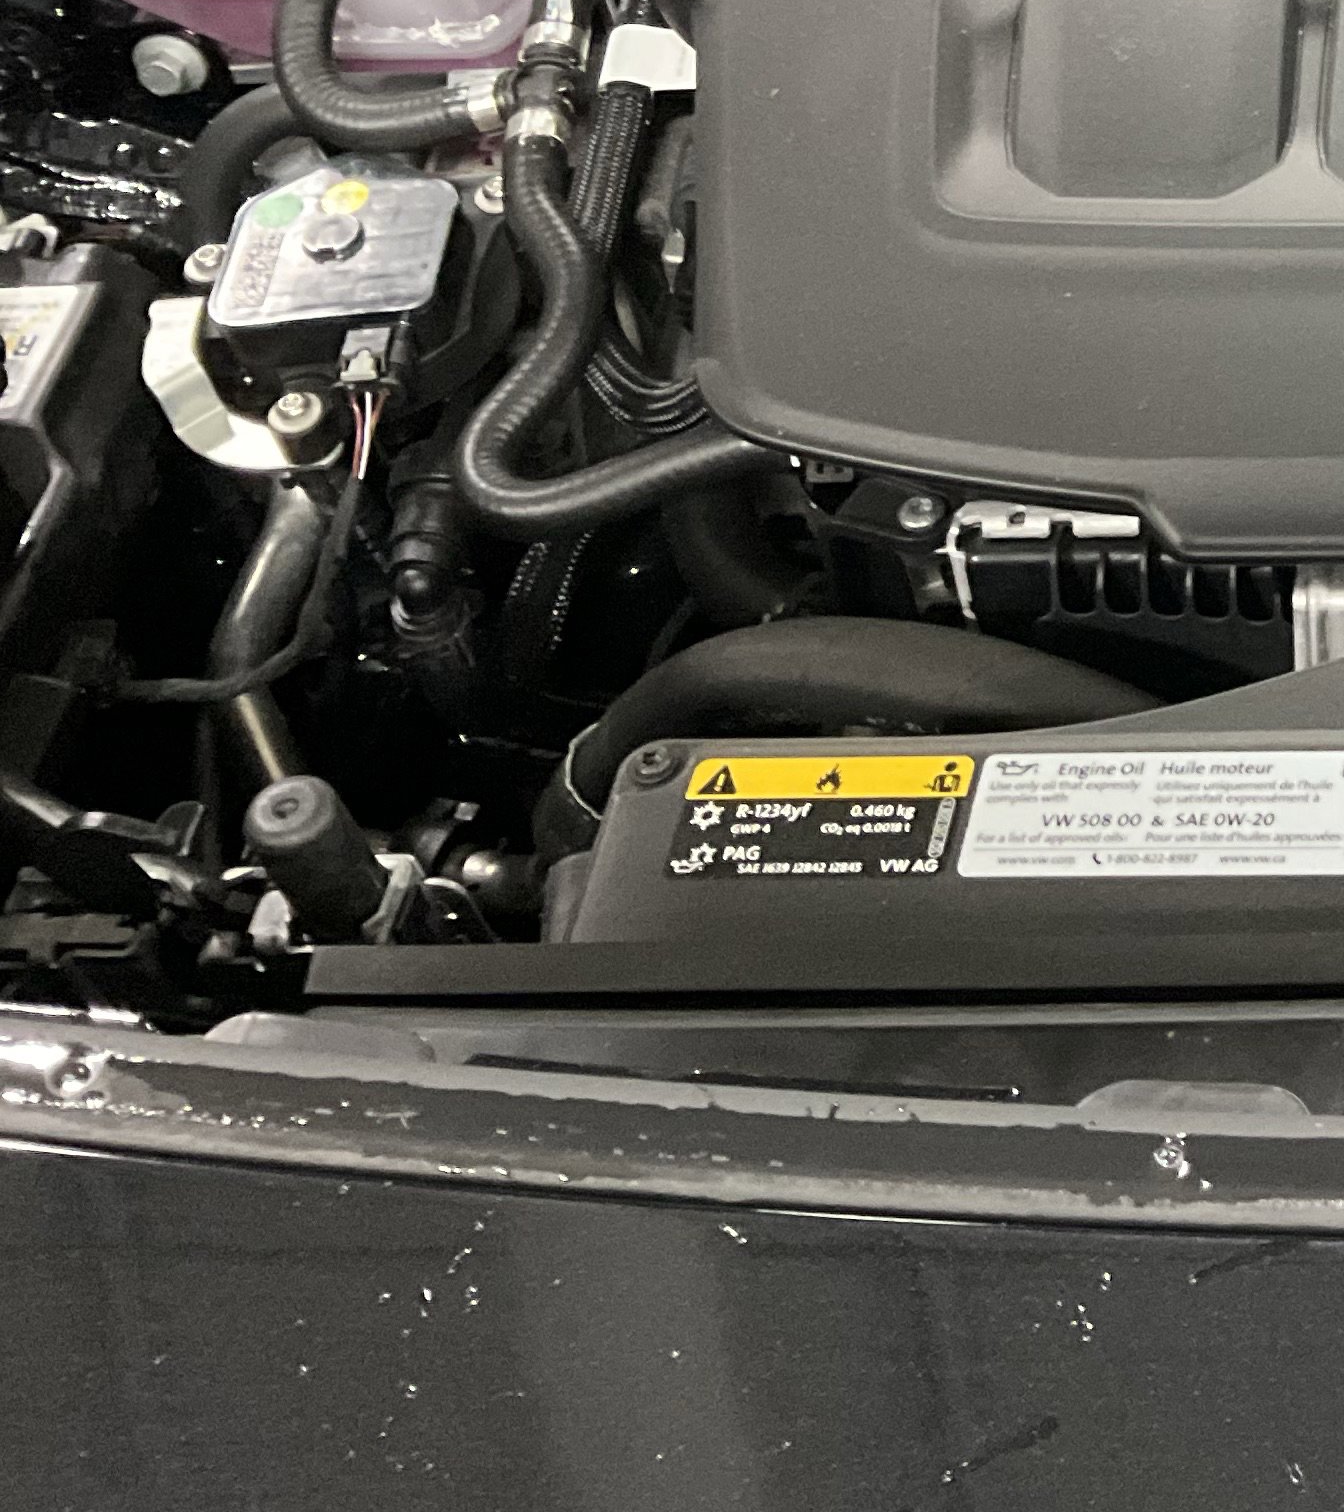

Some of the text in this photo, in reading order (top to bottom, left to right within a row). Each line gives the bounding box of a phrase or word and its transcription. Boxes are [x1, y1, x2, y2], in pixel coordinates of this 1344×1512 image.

[1058, 761, 1145, 779] Engine Oil
[1159, 761, 1274, 775] Huile moteur
[1280, 781, 1295, 790] de
[736, 803, 916, 822] R-1234yf 0.460 kg
[1042, 812, 1276, 827] VW 508 00 & SAE 0W-20
[722, 845, 761, 861] PAG
[880, 858, 910, 873] VW
[911, 858, 939, 873] AG
